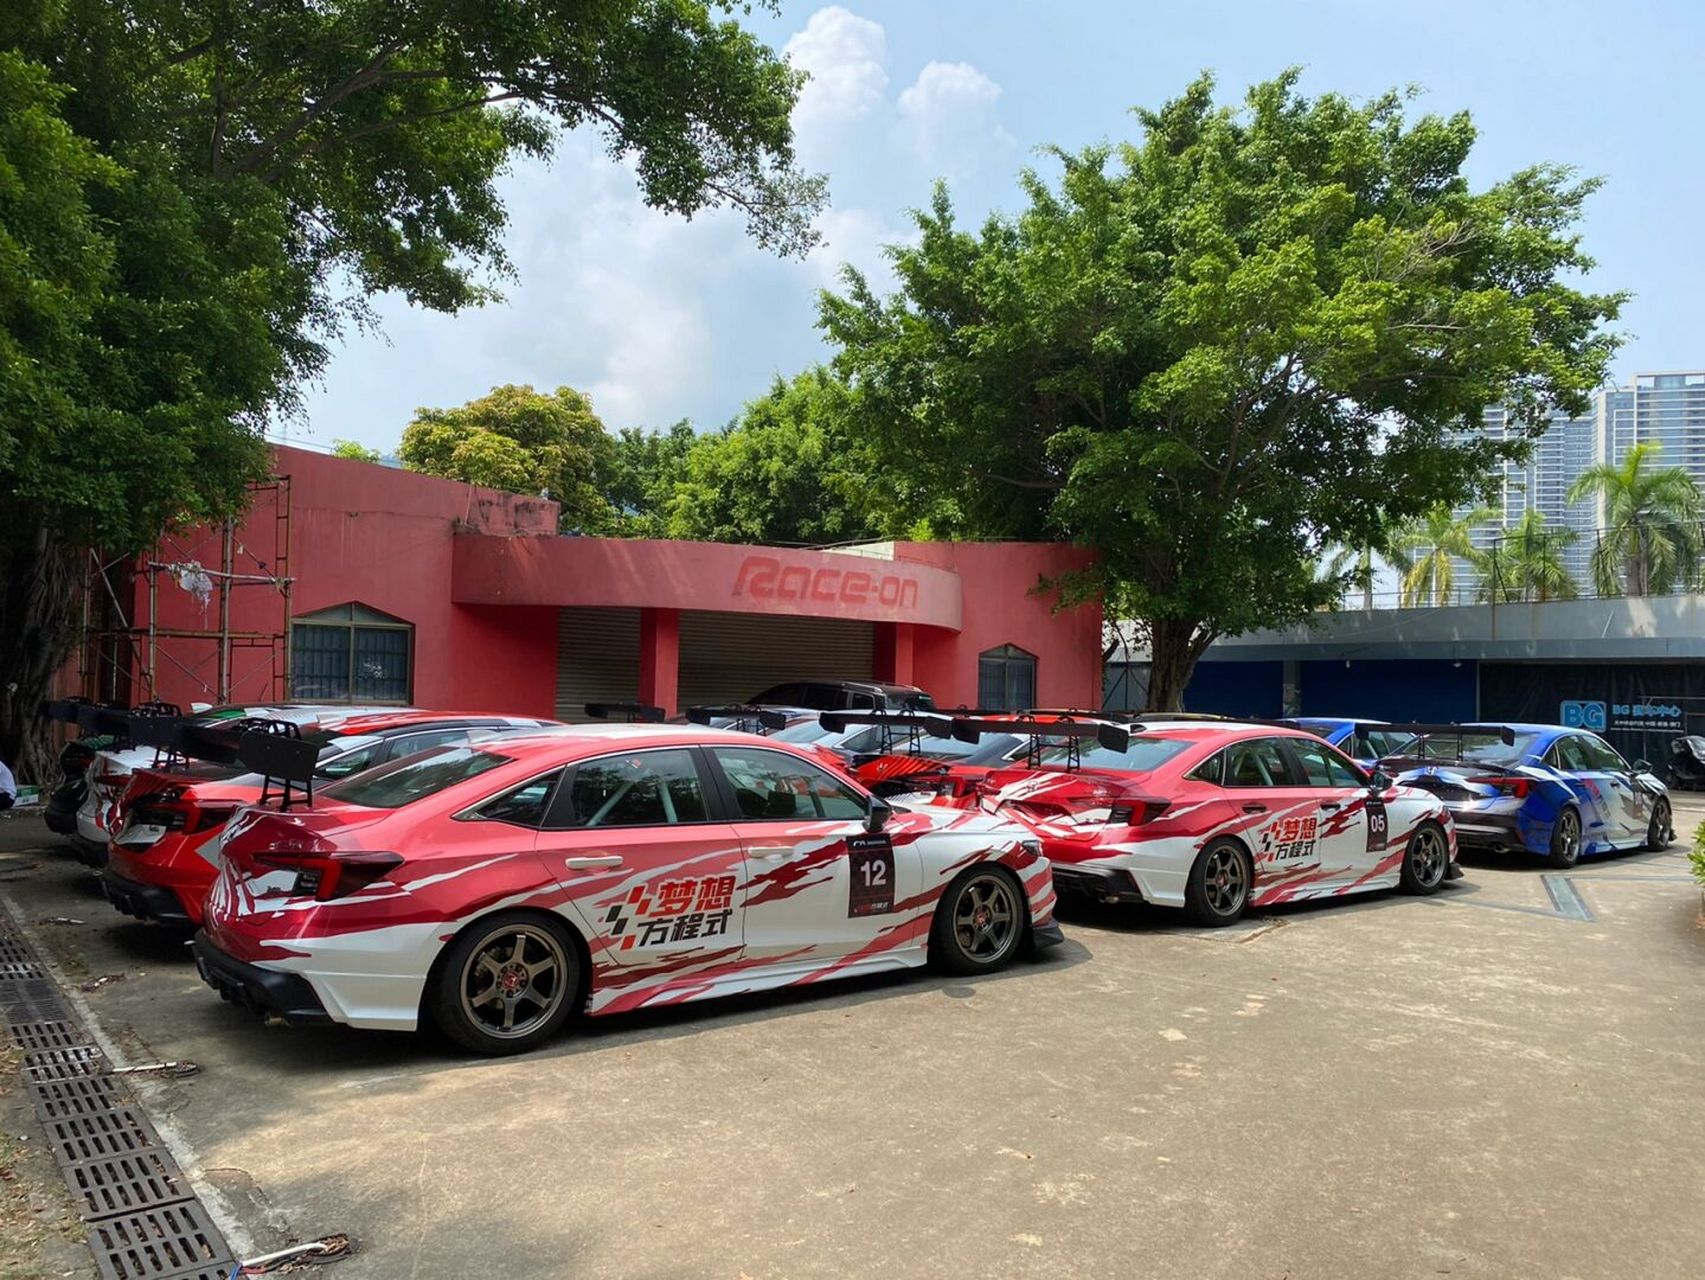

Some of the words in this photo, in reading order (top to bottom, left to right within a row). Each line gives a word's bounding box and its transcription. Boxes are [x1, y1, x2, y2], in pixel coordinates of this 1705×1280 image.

[1562, 702, 1606, 731] BG
[1612, 704, 1630, 716] BG
[1279, 815, 1318, 843] 梦想
[1371, 814, 1386, 833] 05
[1275, 840, 1317, 861] 方程式
[860, 859, 887, 887] 12
[650, 875, 736, 917] 梦想
[637, 908, 734, 948] 方程式
